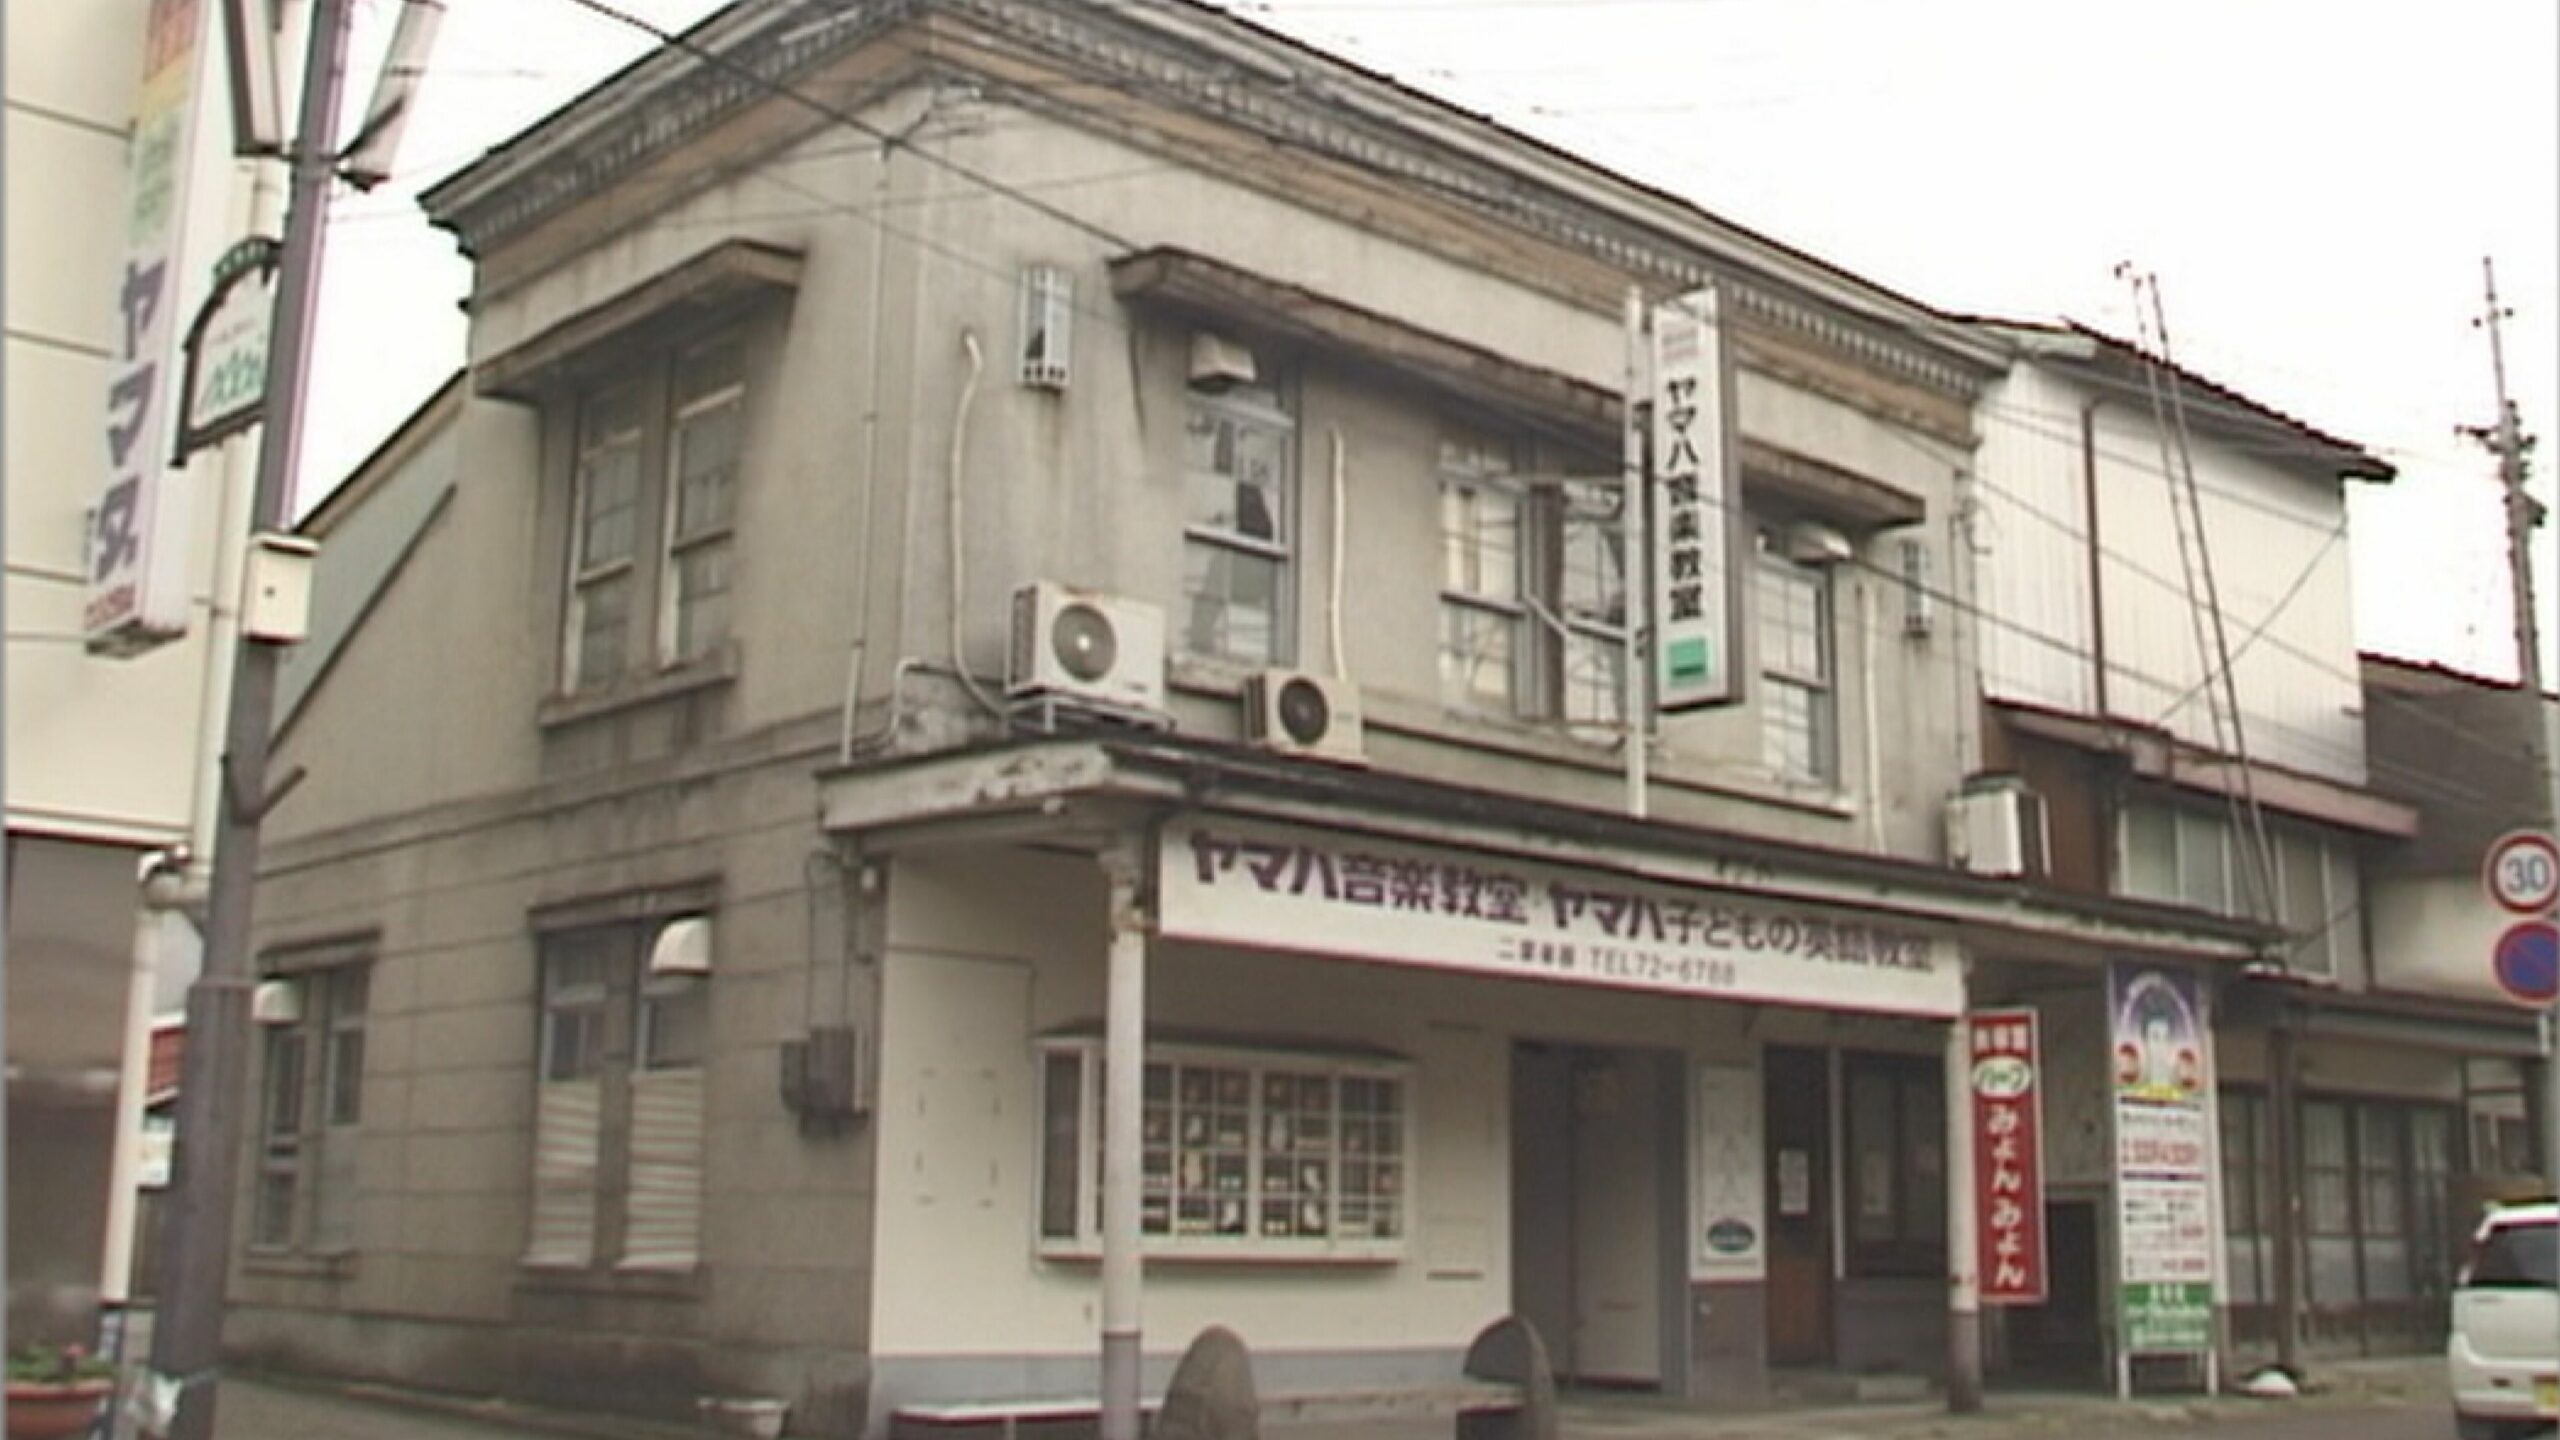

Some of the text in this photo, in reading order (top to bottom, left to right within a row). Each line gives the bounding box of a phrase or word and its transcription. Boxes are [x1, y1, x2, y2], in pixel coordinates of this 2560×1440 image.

[1666, 377, 1704, 622] ヤマハ音楽教室
[2506, 855, 2549, 893] 30
